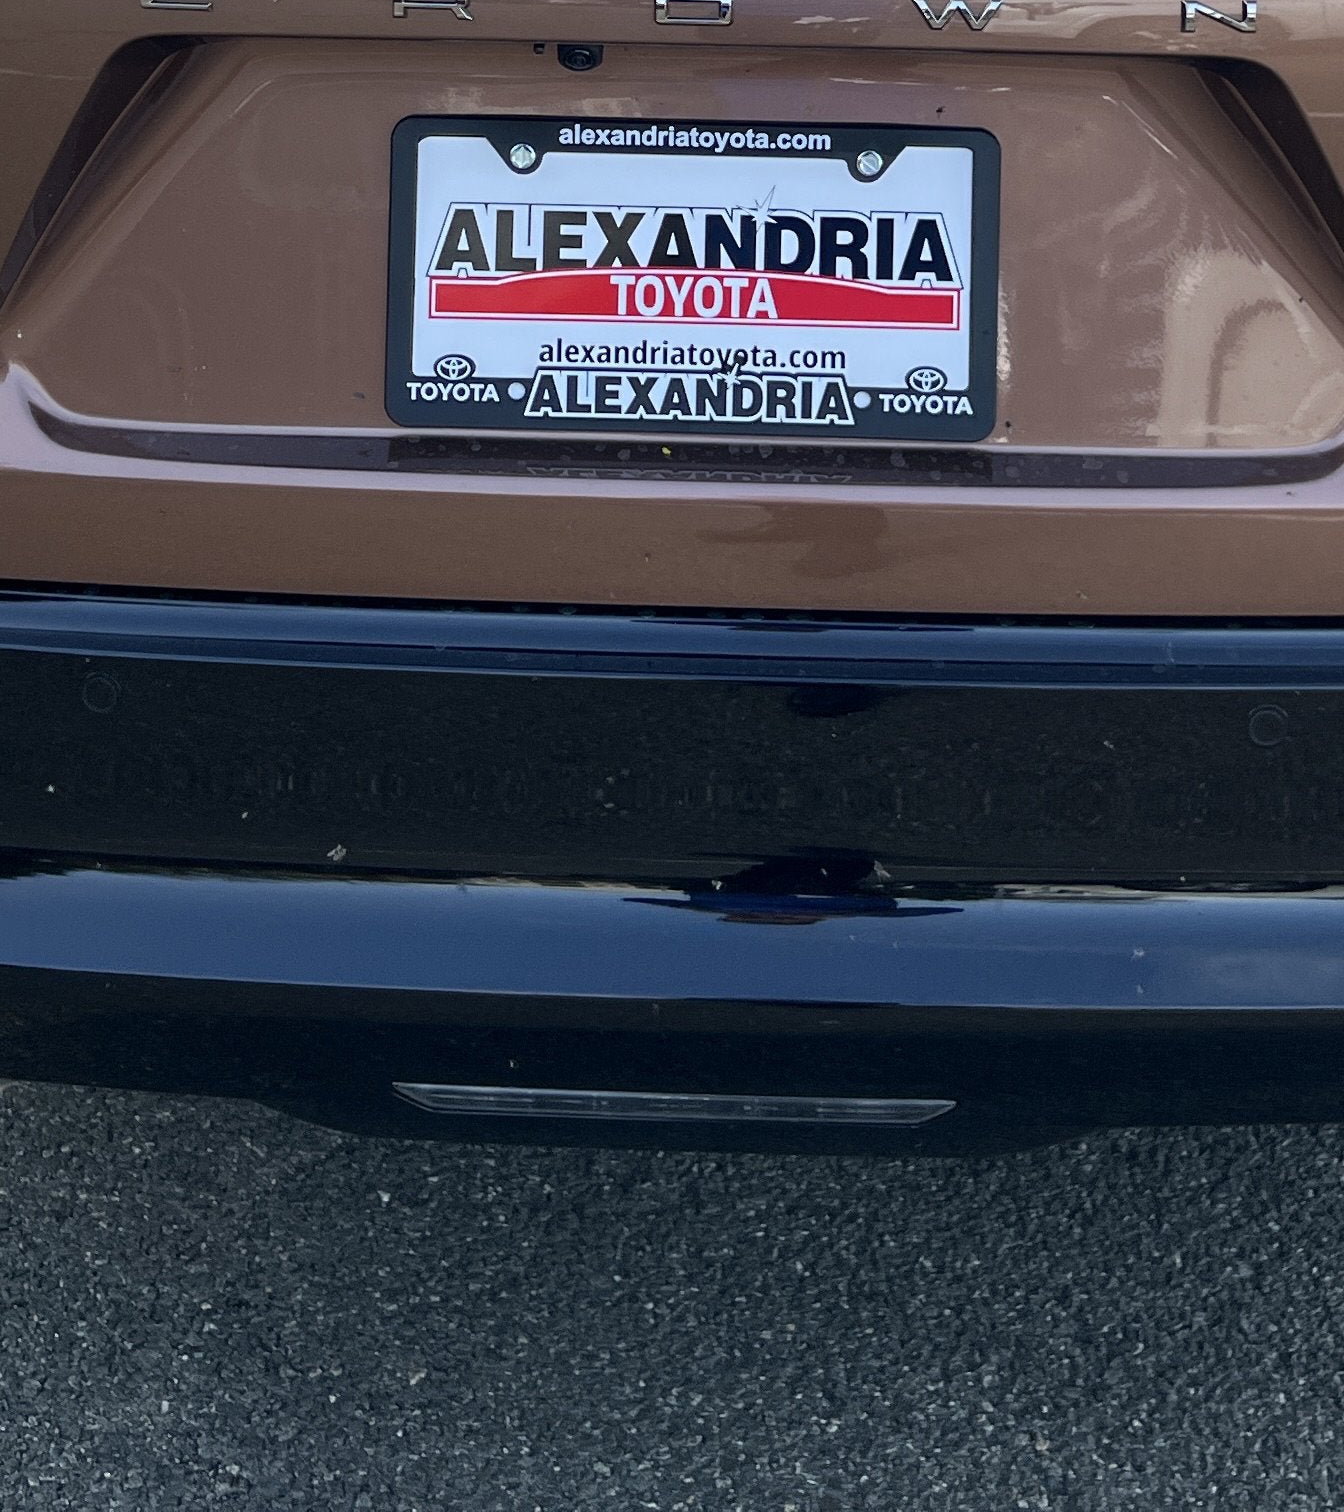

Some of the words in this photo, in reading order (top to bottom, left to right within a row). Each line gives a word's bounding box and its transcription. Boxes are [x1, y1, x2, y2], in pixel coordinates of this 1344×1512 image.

[558, 123, 832, 152] alexandriatoyota.com
[430, 205, 962, 285] ALEXANDRIA
[609, 273, 778, 319] TOYOTA
[538, 339, 847, 371] alexandriatoyota.com
[406, 380, 500, 403] TOYOTA
[525, 368, 855, 424] ALEXANDRIA
[878, 392, 975, 416] TOYOTA
